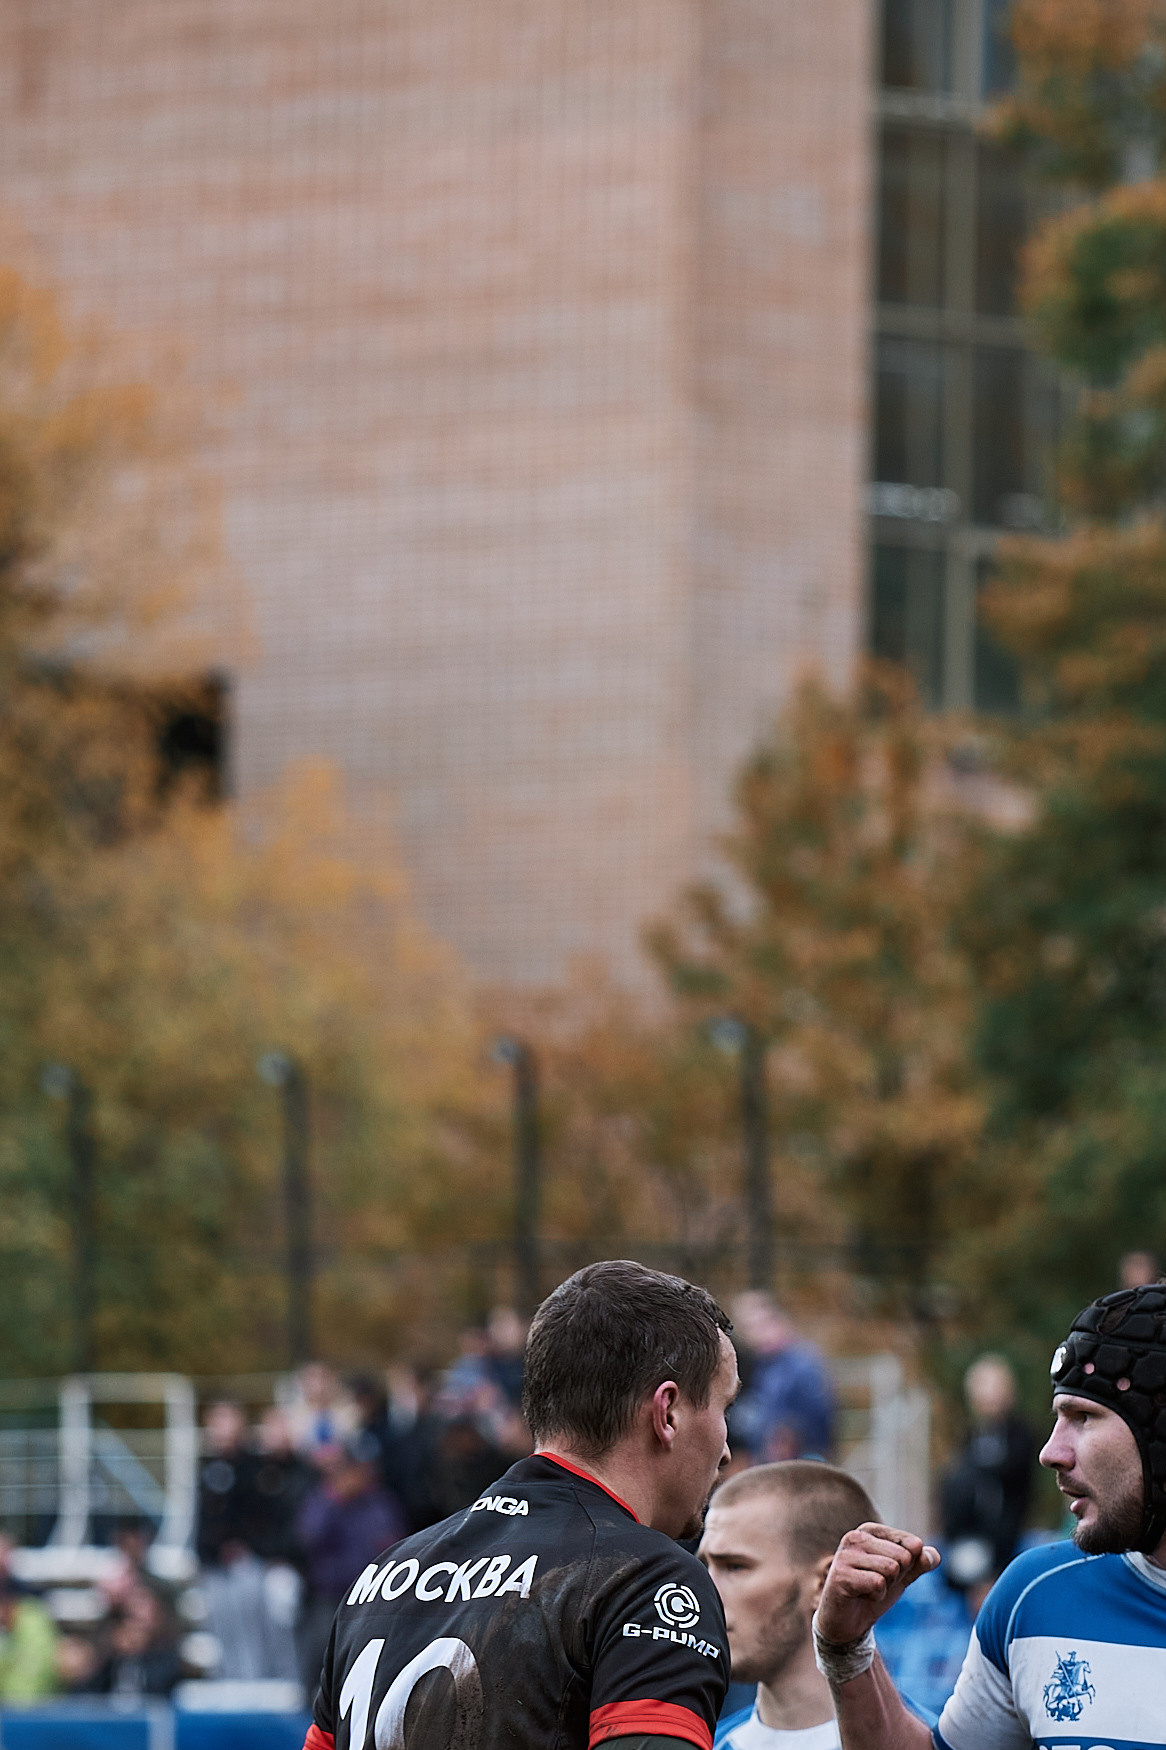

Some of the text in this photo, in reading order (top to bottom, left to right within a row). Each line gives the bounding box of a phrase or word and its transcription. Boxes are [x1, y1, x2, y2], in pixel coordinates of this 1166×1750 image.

[470, 1495, 529, 1516] ONGA
[346, 1555, 539, 1606] МОСКВА
[622, 1623, 721, 1659] G-PUMP
